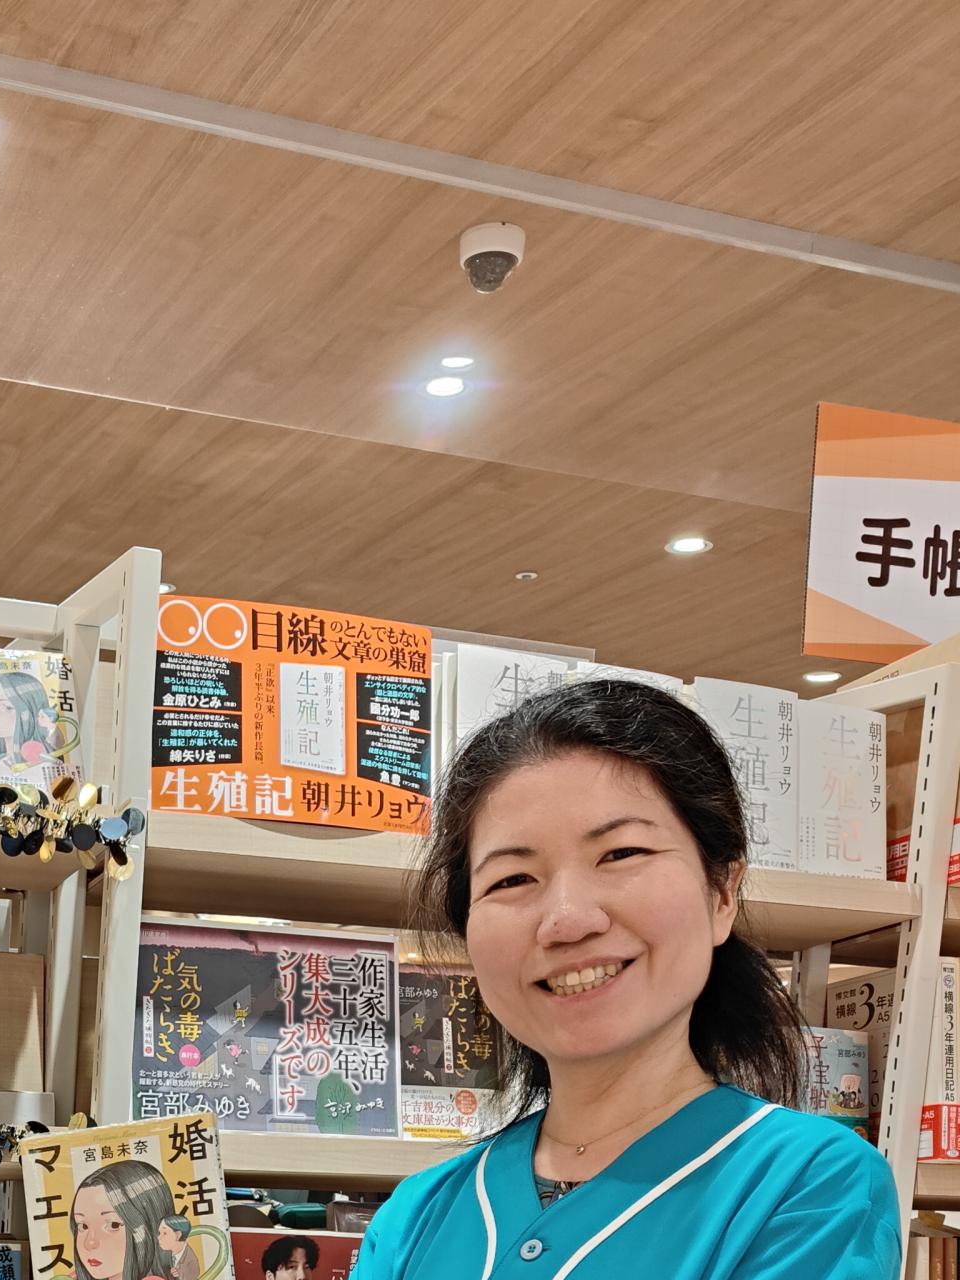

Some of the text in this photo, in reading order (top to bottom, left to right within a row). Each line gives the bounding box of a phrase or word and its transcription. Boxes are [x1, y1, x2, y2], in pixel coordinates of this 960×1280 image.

[329, 636, 427, 675] 文章の巣窟
[330, 620, 428, 648] のとんでもない
[162, 692, 222, 709] 金原ひとみ
[296, 670, 321, 757] 生殖記
[169, 749, 217, 763] 綿矢りさ
[777, 700, 794, 796] 朝井リョウ
[868, 722, 883, 814] 朝井リョウ
[158, 767, 295, 817] 生殖記
[301, 780, 428, 826] 朝井リョウ
[175, 961, 204, 1042] 気の毒
[302, 952, 331, 1077] 集大成の
[331, 955, 361, 1093] 三十五年、
[876, 1012, 890, 1023] A5
[808, 1035, 830, 1111] 子宝船
[137, 1087, 251, 1120] 宮部みゆき
[82, 1139, 149, 1163] 宮島未奈
[167, 1118, 218, 1218] 婚活
